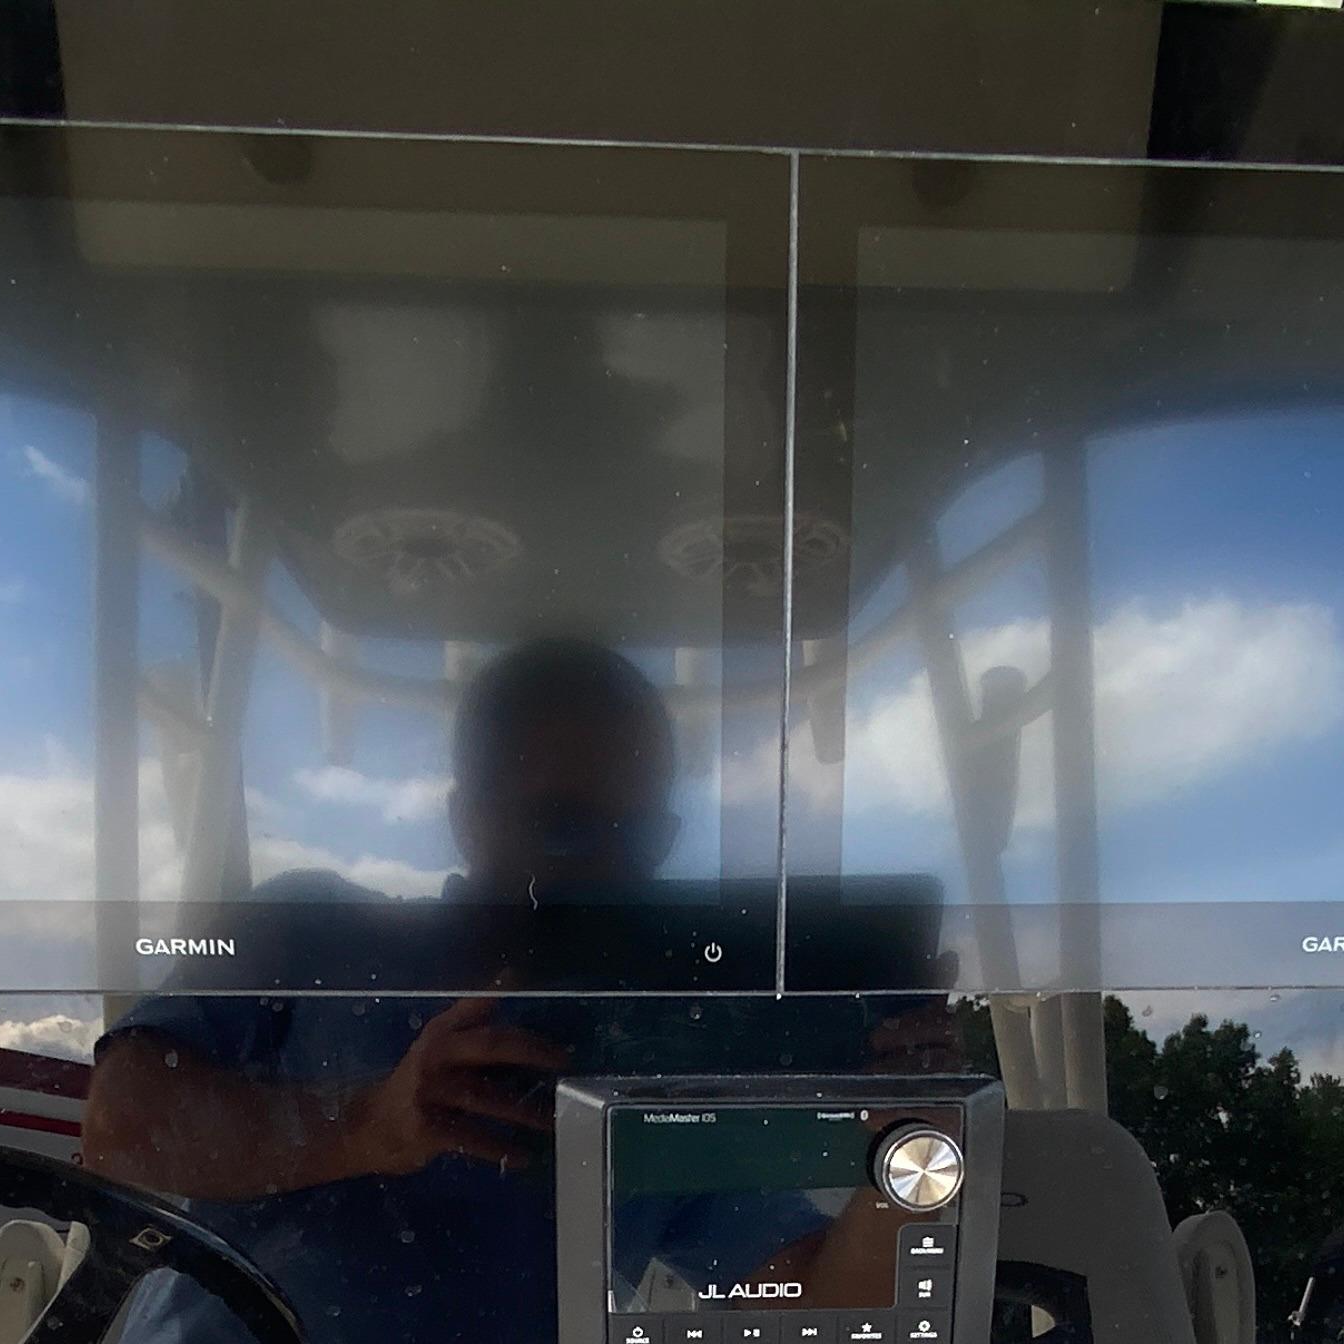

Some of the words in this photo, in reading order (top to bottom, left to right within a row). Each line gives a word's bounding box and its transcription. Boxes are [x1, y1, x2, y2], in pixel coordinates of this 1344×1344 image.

[135, 938, 235, 956] GARMIN
[698, 1284, 726, 1299] JL
[728, 1282, 802, 1298] AUDIO
